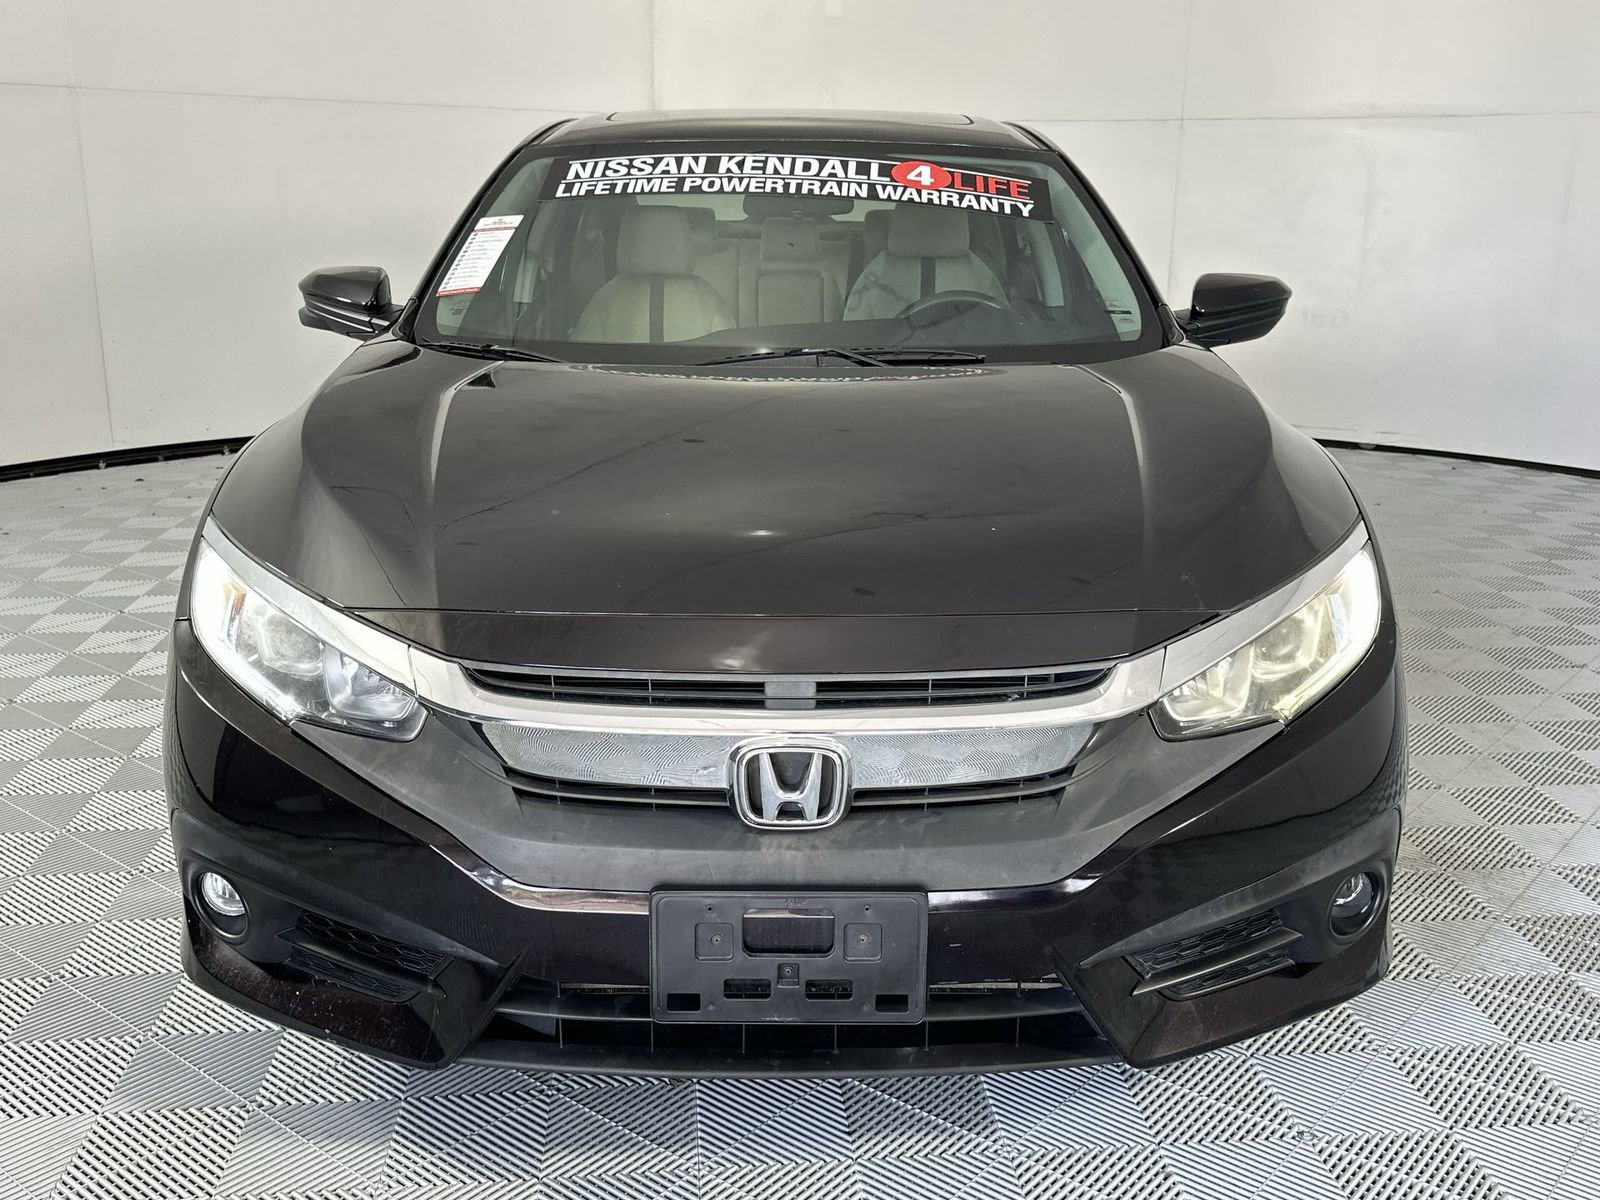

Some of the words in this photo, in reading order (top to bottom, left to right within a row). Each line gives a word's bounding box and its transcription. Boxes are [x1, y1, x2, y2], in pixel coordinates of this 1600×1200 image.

[555, 177, 678, 198] LIFETIME
[682, 177, 868, 198] POWERTRAIN
[876, 184, 1034, 218] WARRANTY
[566, 157, 707, 180] NISSAN
[717, 156, 891, 182] KENDALL
[906, 165, 934, 186] 4
[953, 172, 1032, 200] LIFE
